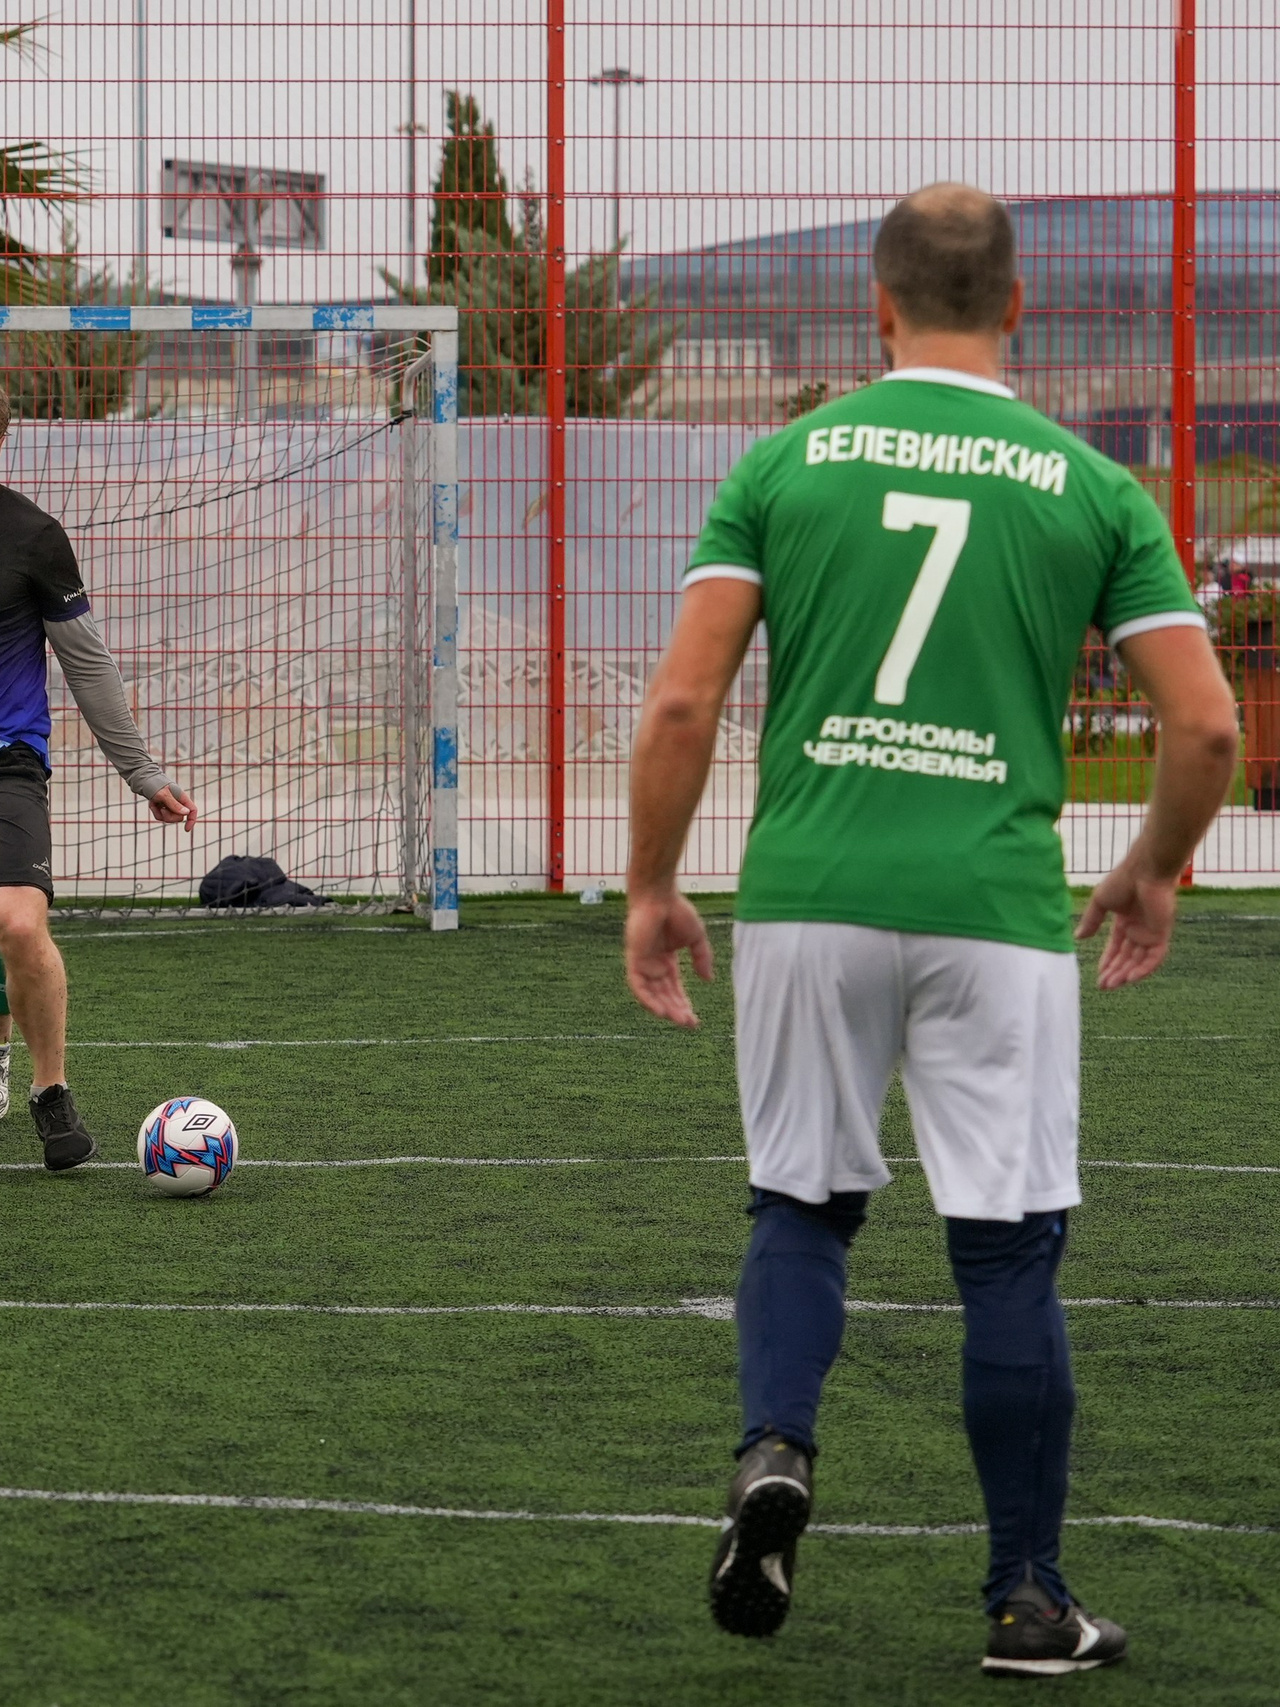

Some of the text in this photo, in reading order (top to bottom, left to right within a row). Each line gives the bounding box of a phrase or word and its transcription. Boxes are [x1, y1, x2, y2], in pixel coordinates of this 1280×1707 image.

[805, 425, 1068, 496] БЕЛЕВИНСКИЙ
[874, 491, 972, 705] 7
[803, 740, 1008, 784] ЧЕРНОЗЕМЬЯ
[820, 715, 996, 756] АГРОНОМЫ
